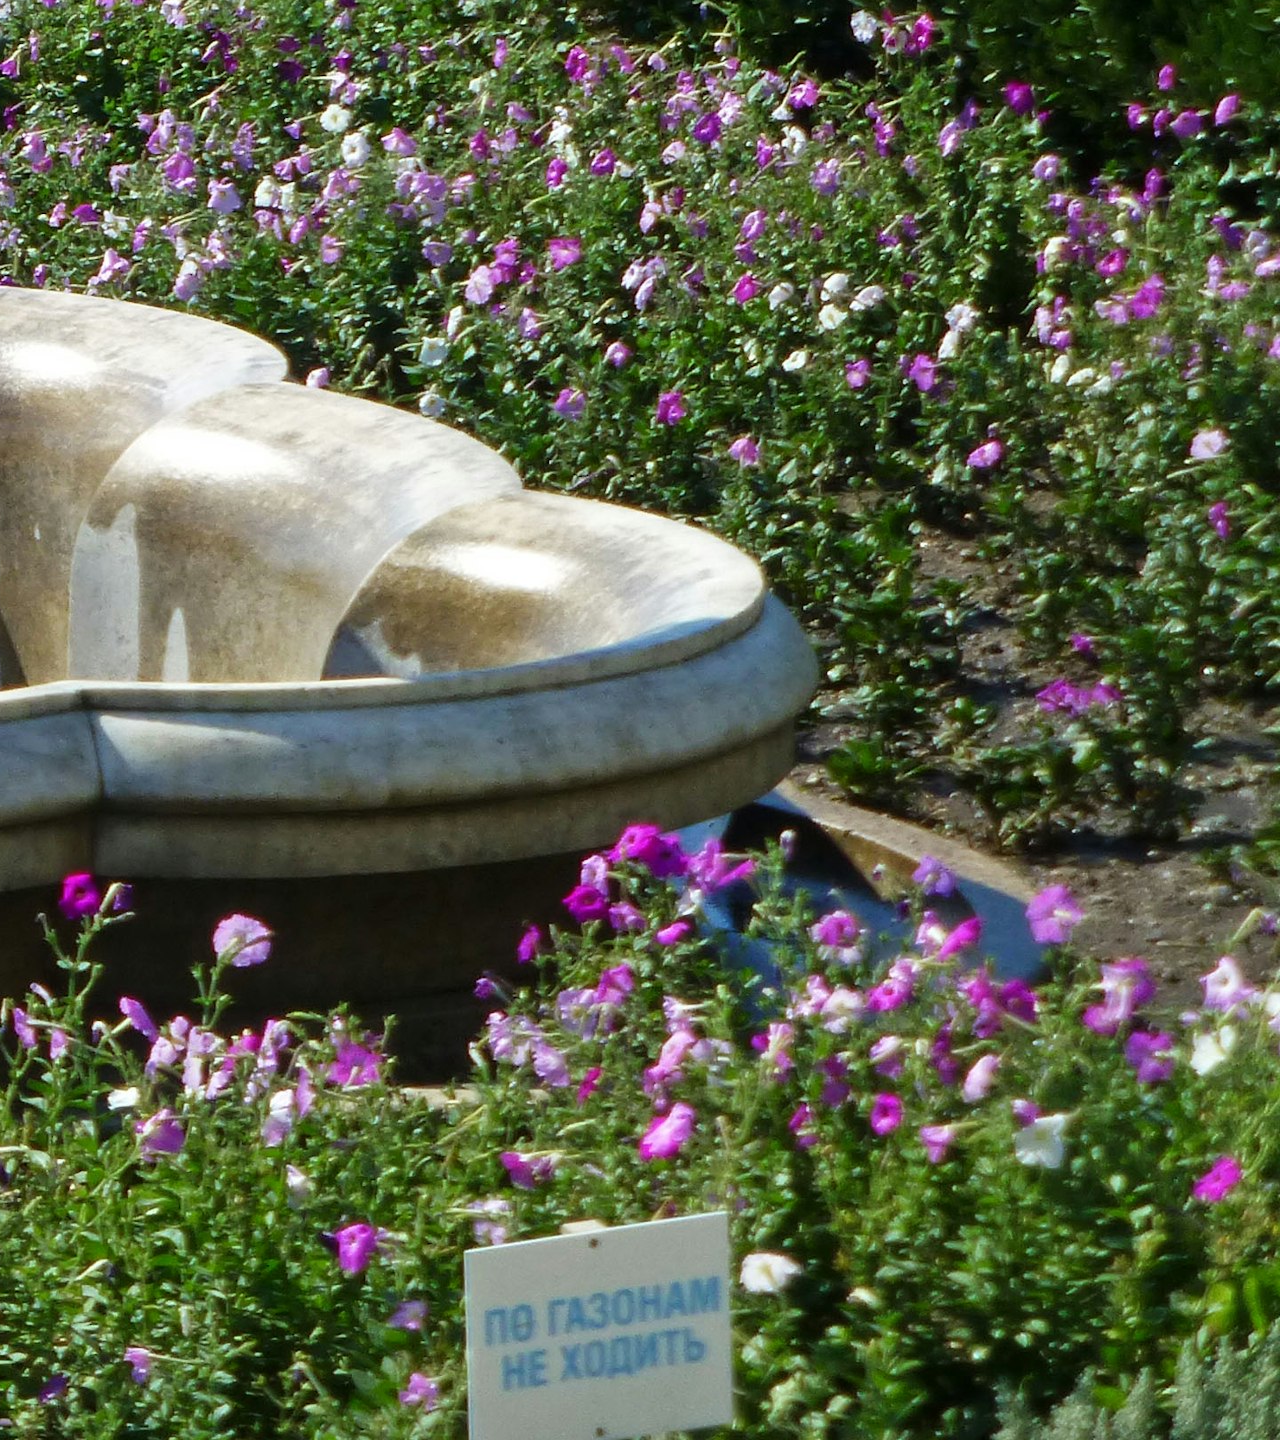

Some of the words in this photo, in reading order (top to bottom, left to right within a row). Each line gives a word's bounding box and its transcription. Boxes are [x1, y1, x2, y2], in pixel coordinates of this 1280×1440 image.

[484, 1304, 535, 1346] ПО
[547, 1276, 721, 1336] ГАЗОНАМ
[501, 1348, 548, 1391] НЕ
[560, 1327, 706, 1381] ХОДИТЬ
